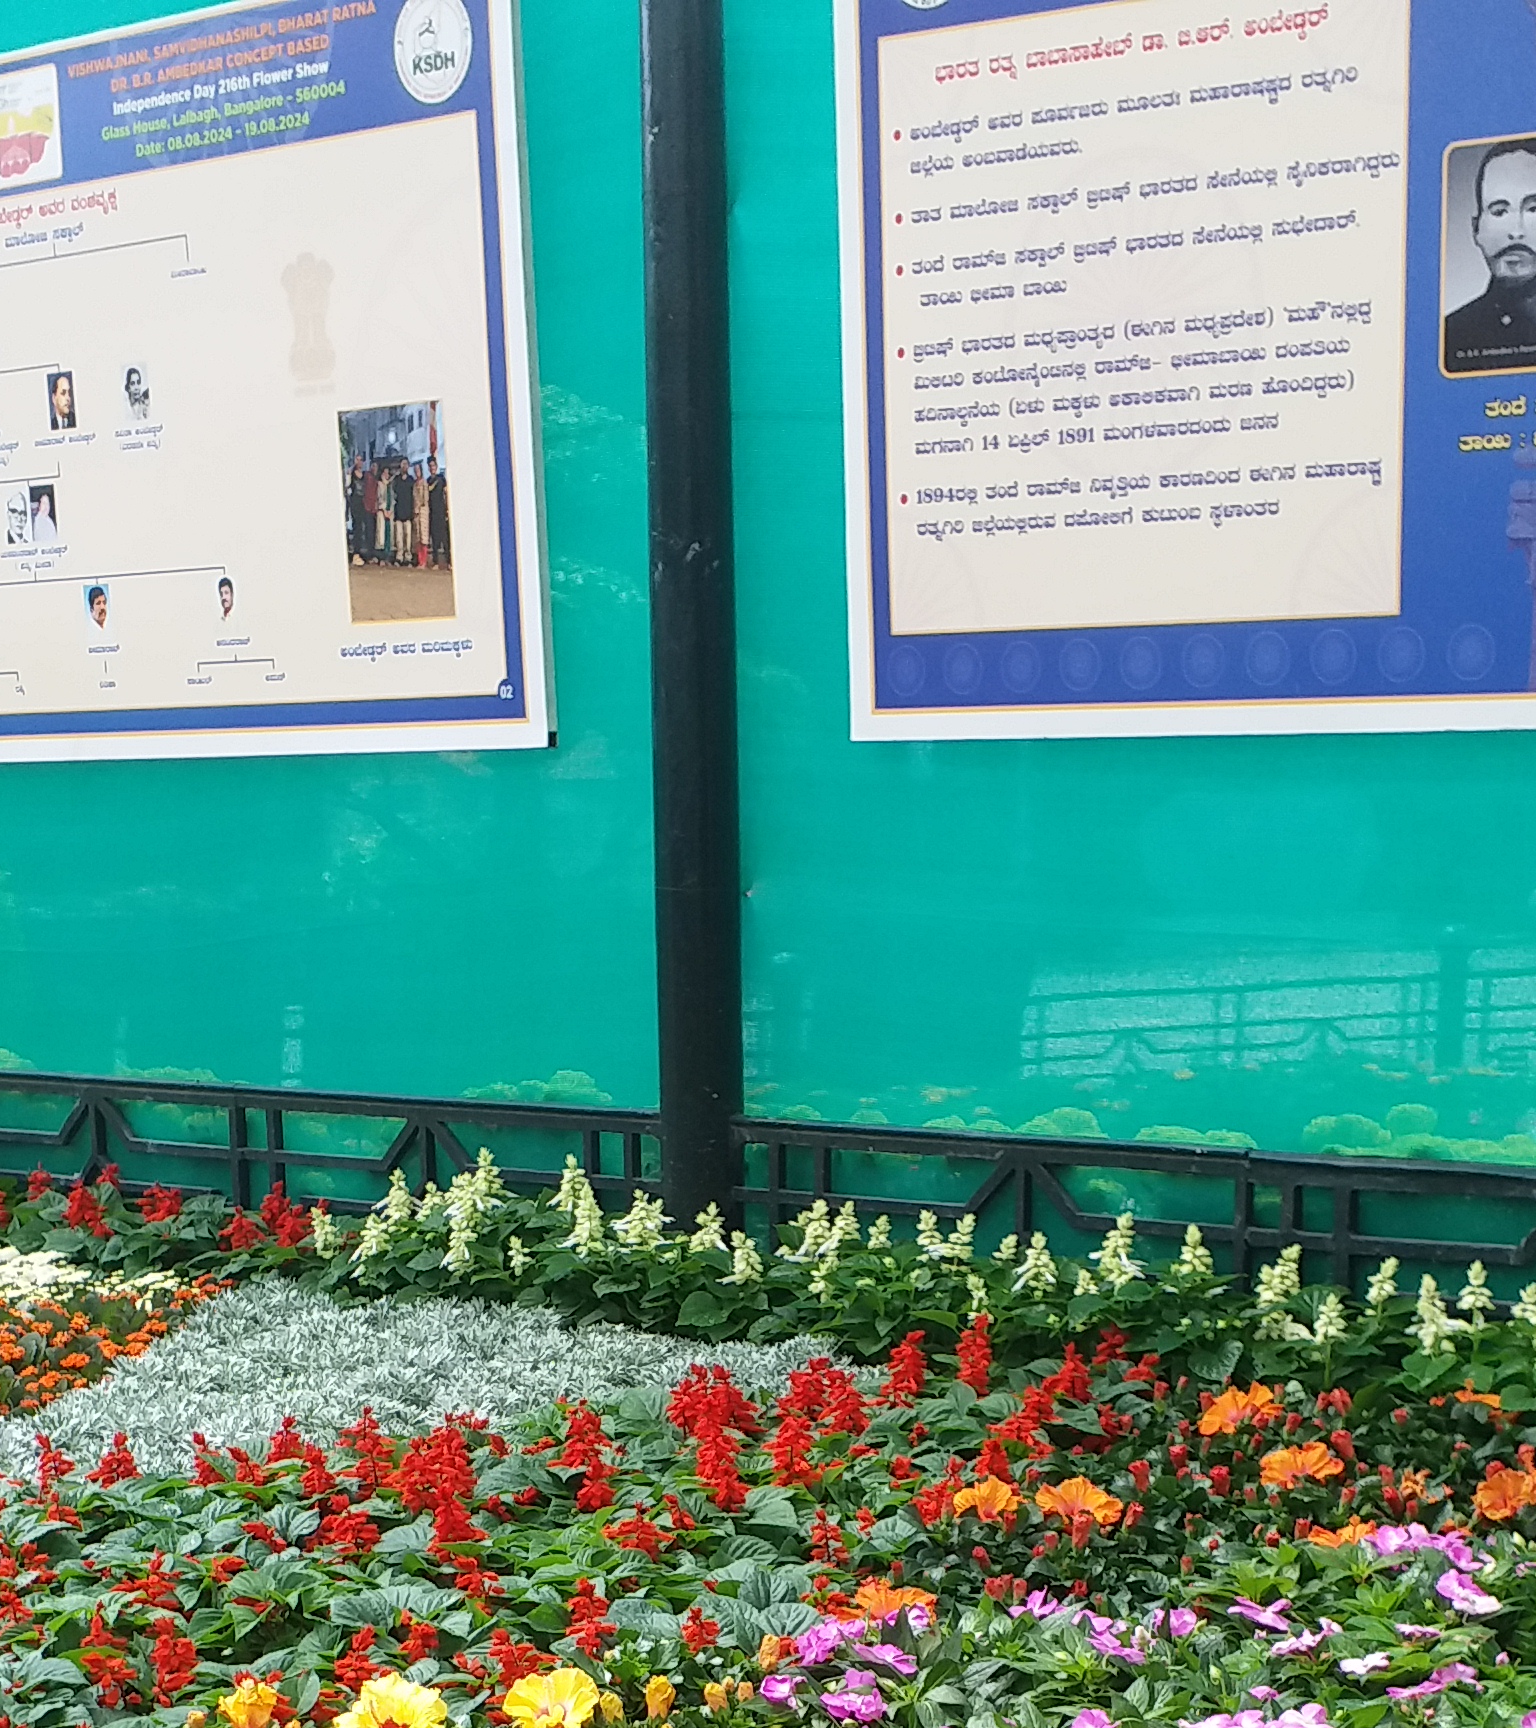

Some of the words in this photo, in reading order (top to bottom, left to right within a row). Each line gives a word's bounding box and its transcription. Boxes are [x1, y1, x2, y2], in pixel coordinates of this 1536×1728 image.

[411, 50, 456, 77] KSDH
[112, 89, 192, 116] Independence
[193, 84, 216, 99] Day
[218, 74, 251, 95] 216th
[252, 68, 294, 87] Flower
[295, 60, 329, 79] Show
[101, 125, 131, 141] Glass
[132, 118, 171, 135] House,
[172, 105, 222, 127] Lalbagh,
[223, 94, 284, 117] Bangalore
[295, 79, 346, 103] 560004
[135, 141, 165, 157] Date:
[167, 125, 233, 151] 08.08.2024
[244, 110, 310, 136] 19.08.2024
[981, 434, 1001, 451] 14
[1058, 426, 1095, 446] 1891
[498, 683, 515, 701] 02
